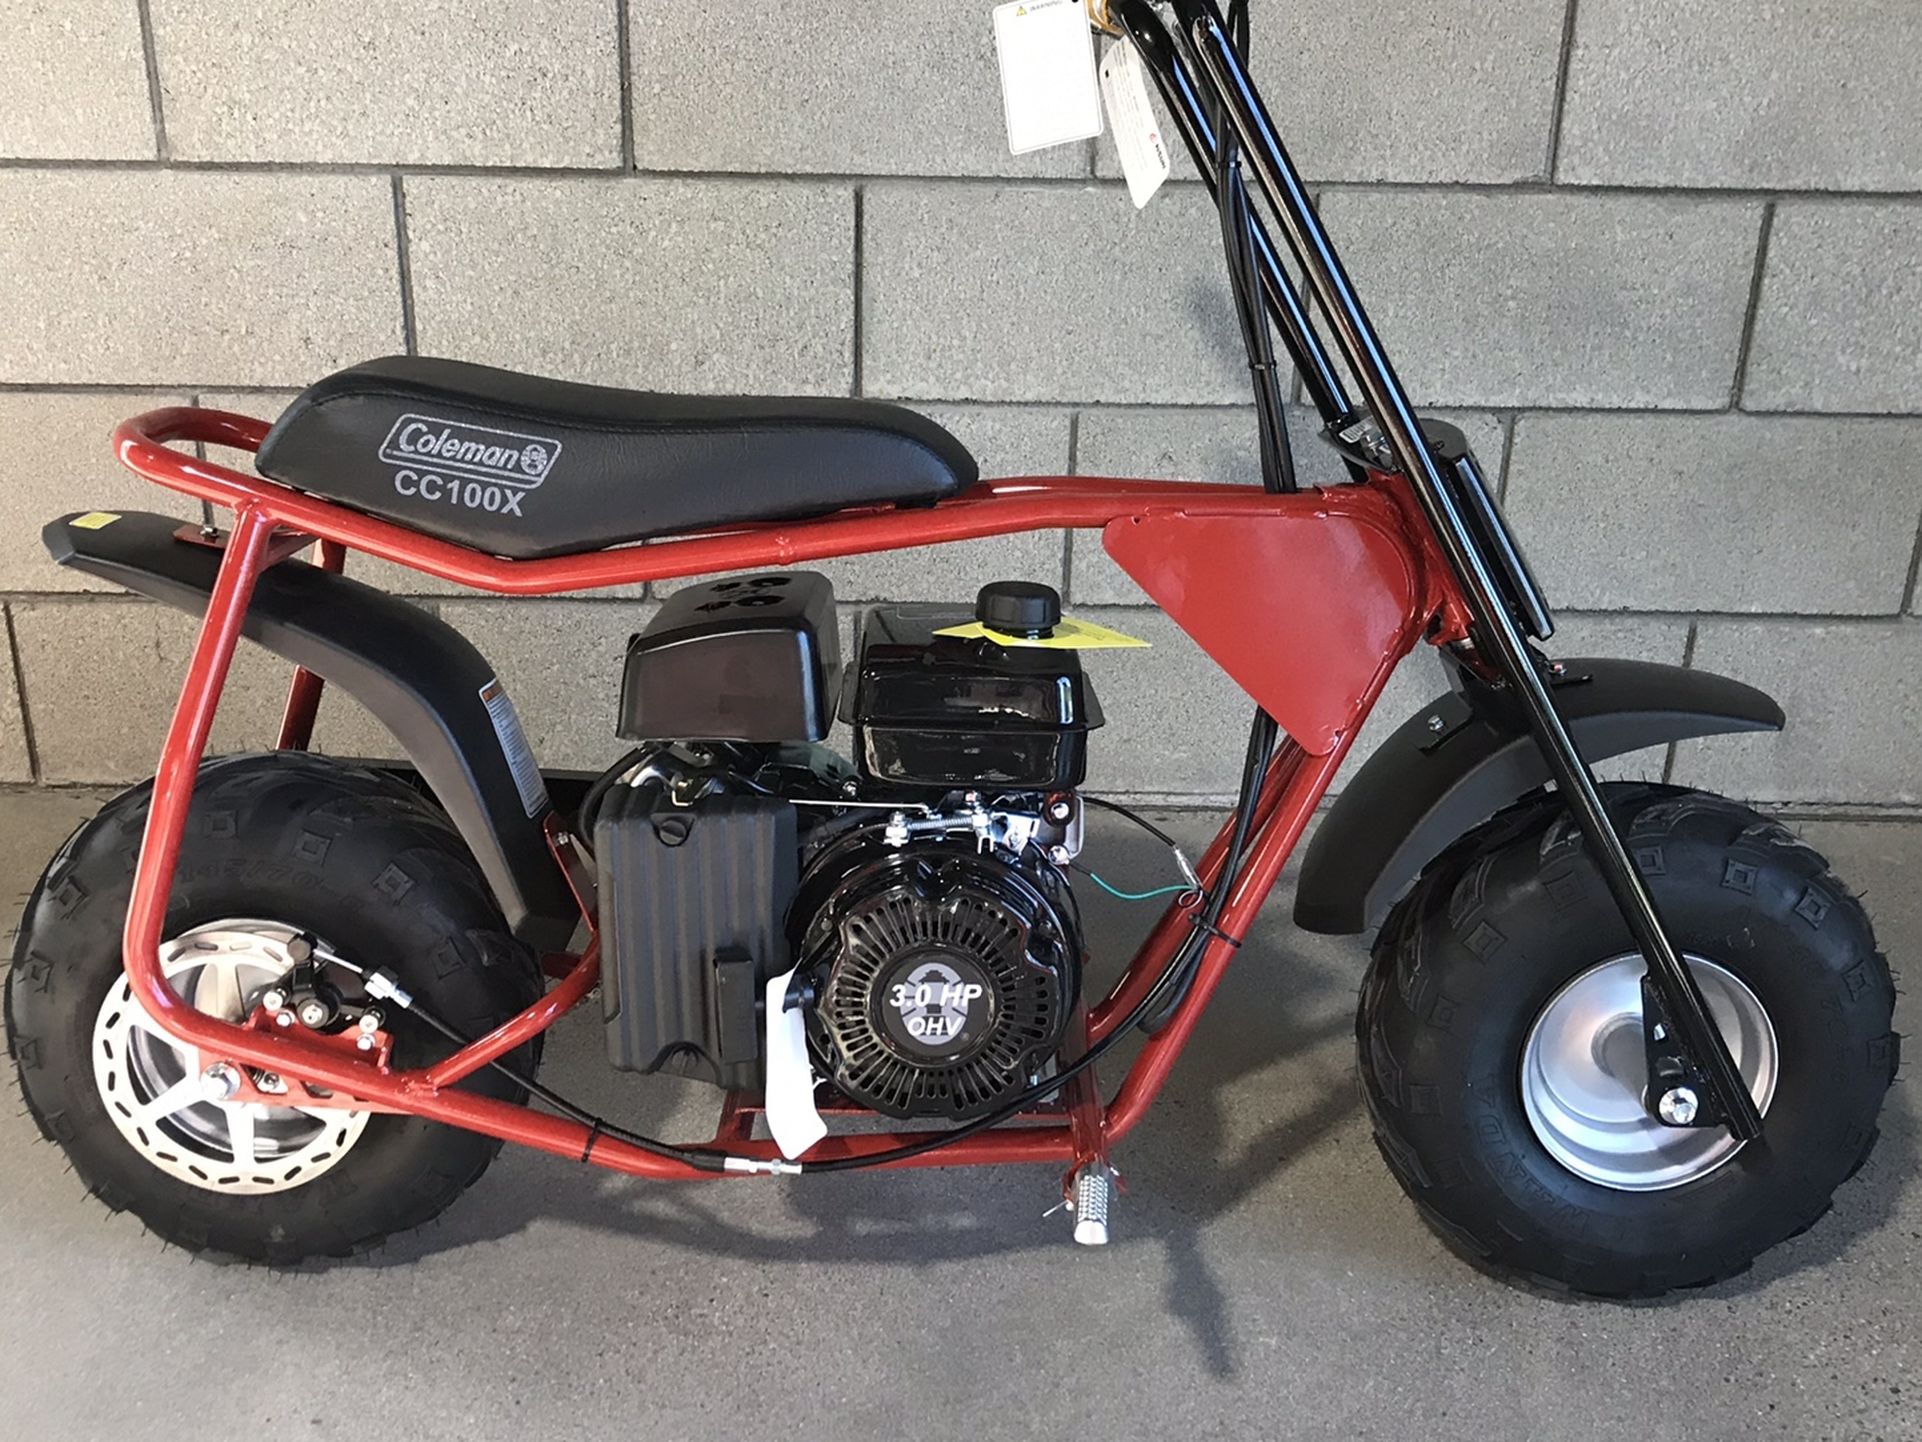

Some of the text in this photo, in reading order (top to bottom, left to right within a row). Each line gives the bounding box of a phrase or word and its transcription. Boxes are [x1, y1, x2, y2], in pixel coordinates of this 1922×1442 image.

[399, 423, 520, 469] Coleman
[394, 470, 526, 517] CC100X
[889, 984, 983, 1007] 3.0 HP
[907, 1017, 964, 1037] OHV
